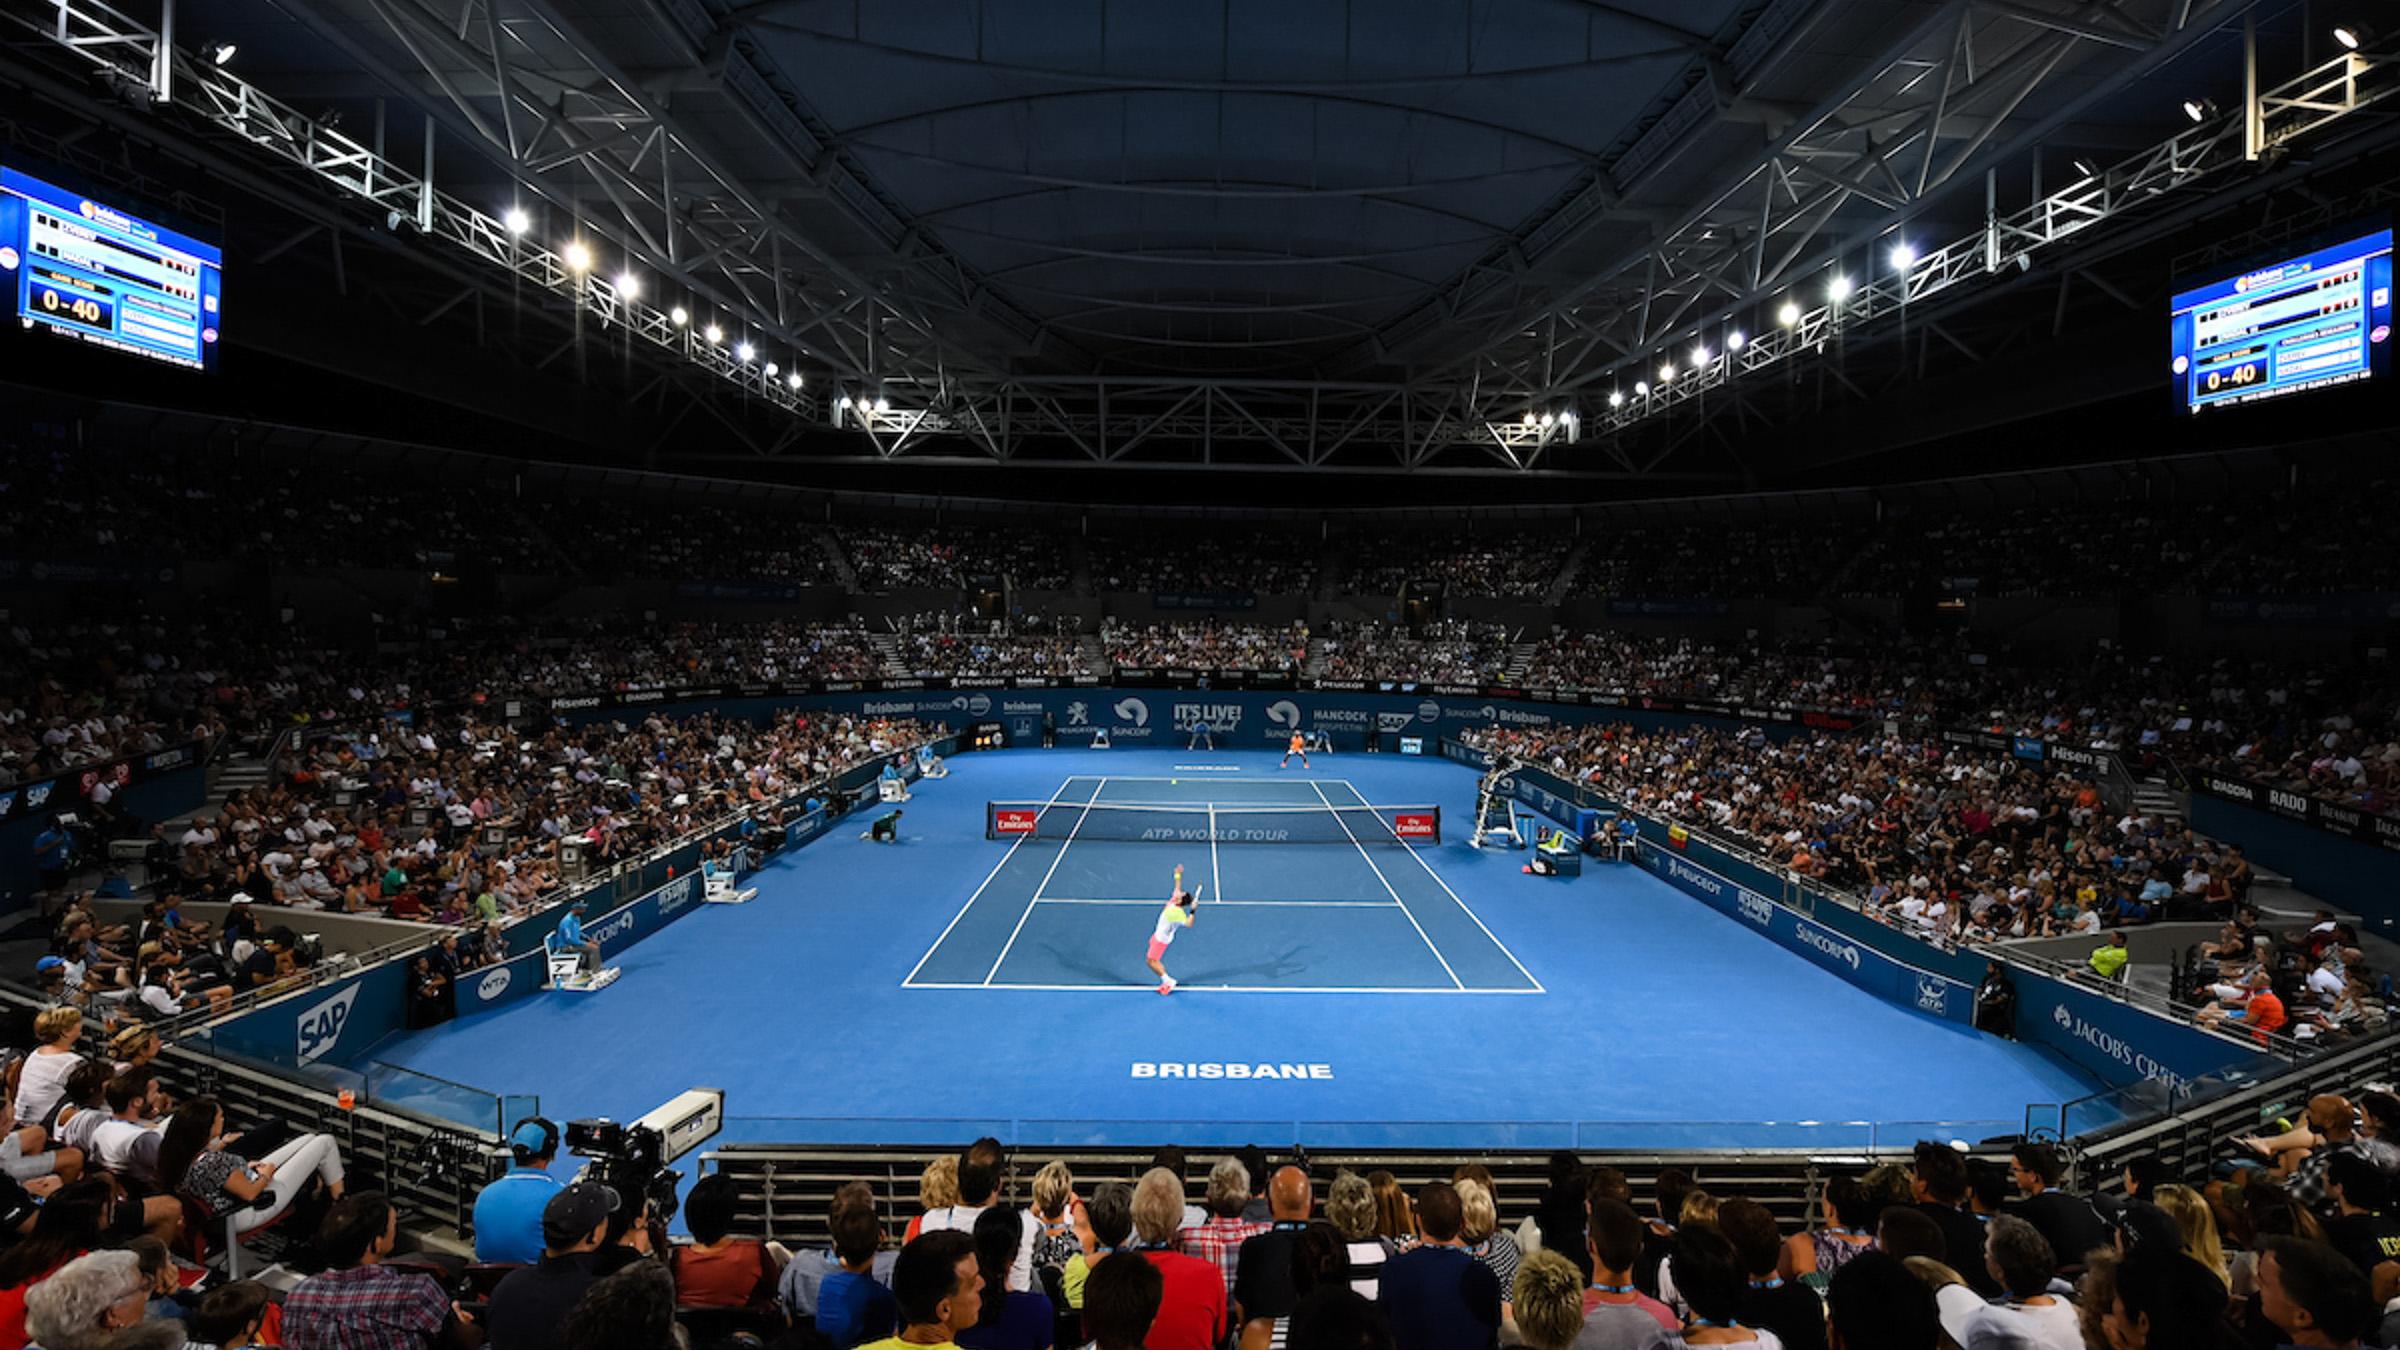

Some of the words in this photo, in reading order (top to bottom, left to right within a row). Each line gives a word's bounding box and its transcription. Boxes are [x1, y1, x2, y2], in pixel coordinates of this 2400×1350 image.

[863, 702, 914, 715] Brisbane
[1203, 704, 1242, 720] LIVE!
[1313, 709, 1368, 721] HANCOCK
[1500, 710, 1551, 725] Brisbane
[1112, 727, 1152, 737] SUNCORP
[2269, 789, 2307, 813] RADO
[998, 820, 1033, 829] Emirates
[1396, 824, 1431, 834] Emirates
[1142, 828, 1174, 839] ATP
[1179, 828, 1240, 840] WORLD
[1245, 829, 1290, 841] TOUR
[1795, 923, 1843, 958] SUNCORP
[481, 974, 507, 993] WTA
[300, 1001, 347, 1051] SAP
[2072, 1017, 2133, 1065] JACOB'S
[1131, 1062, 1334, 1080] BRISBANE
